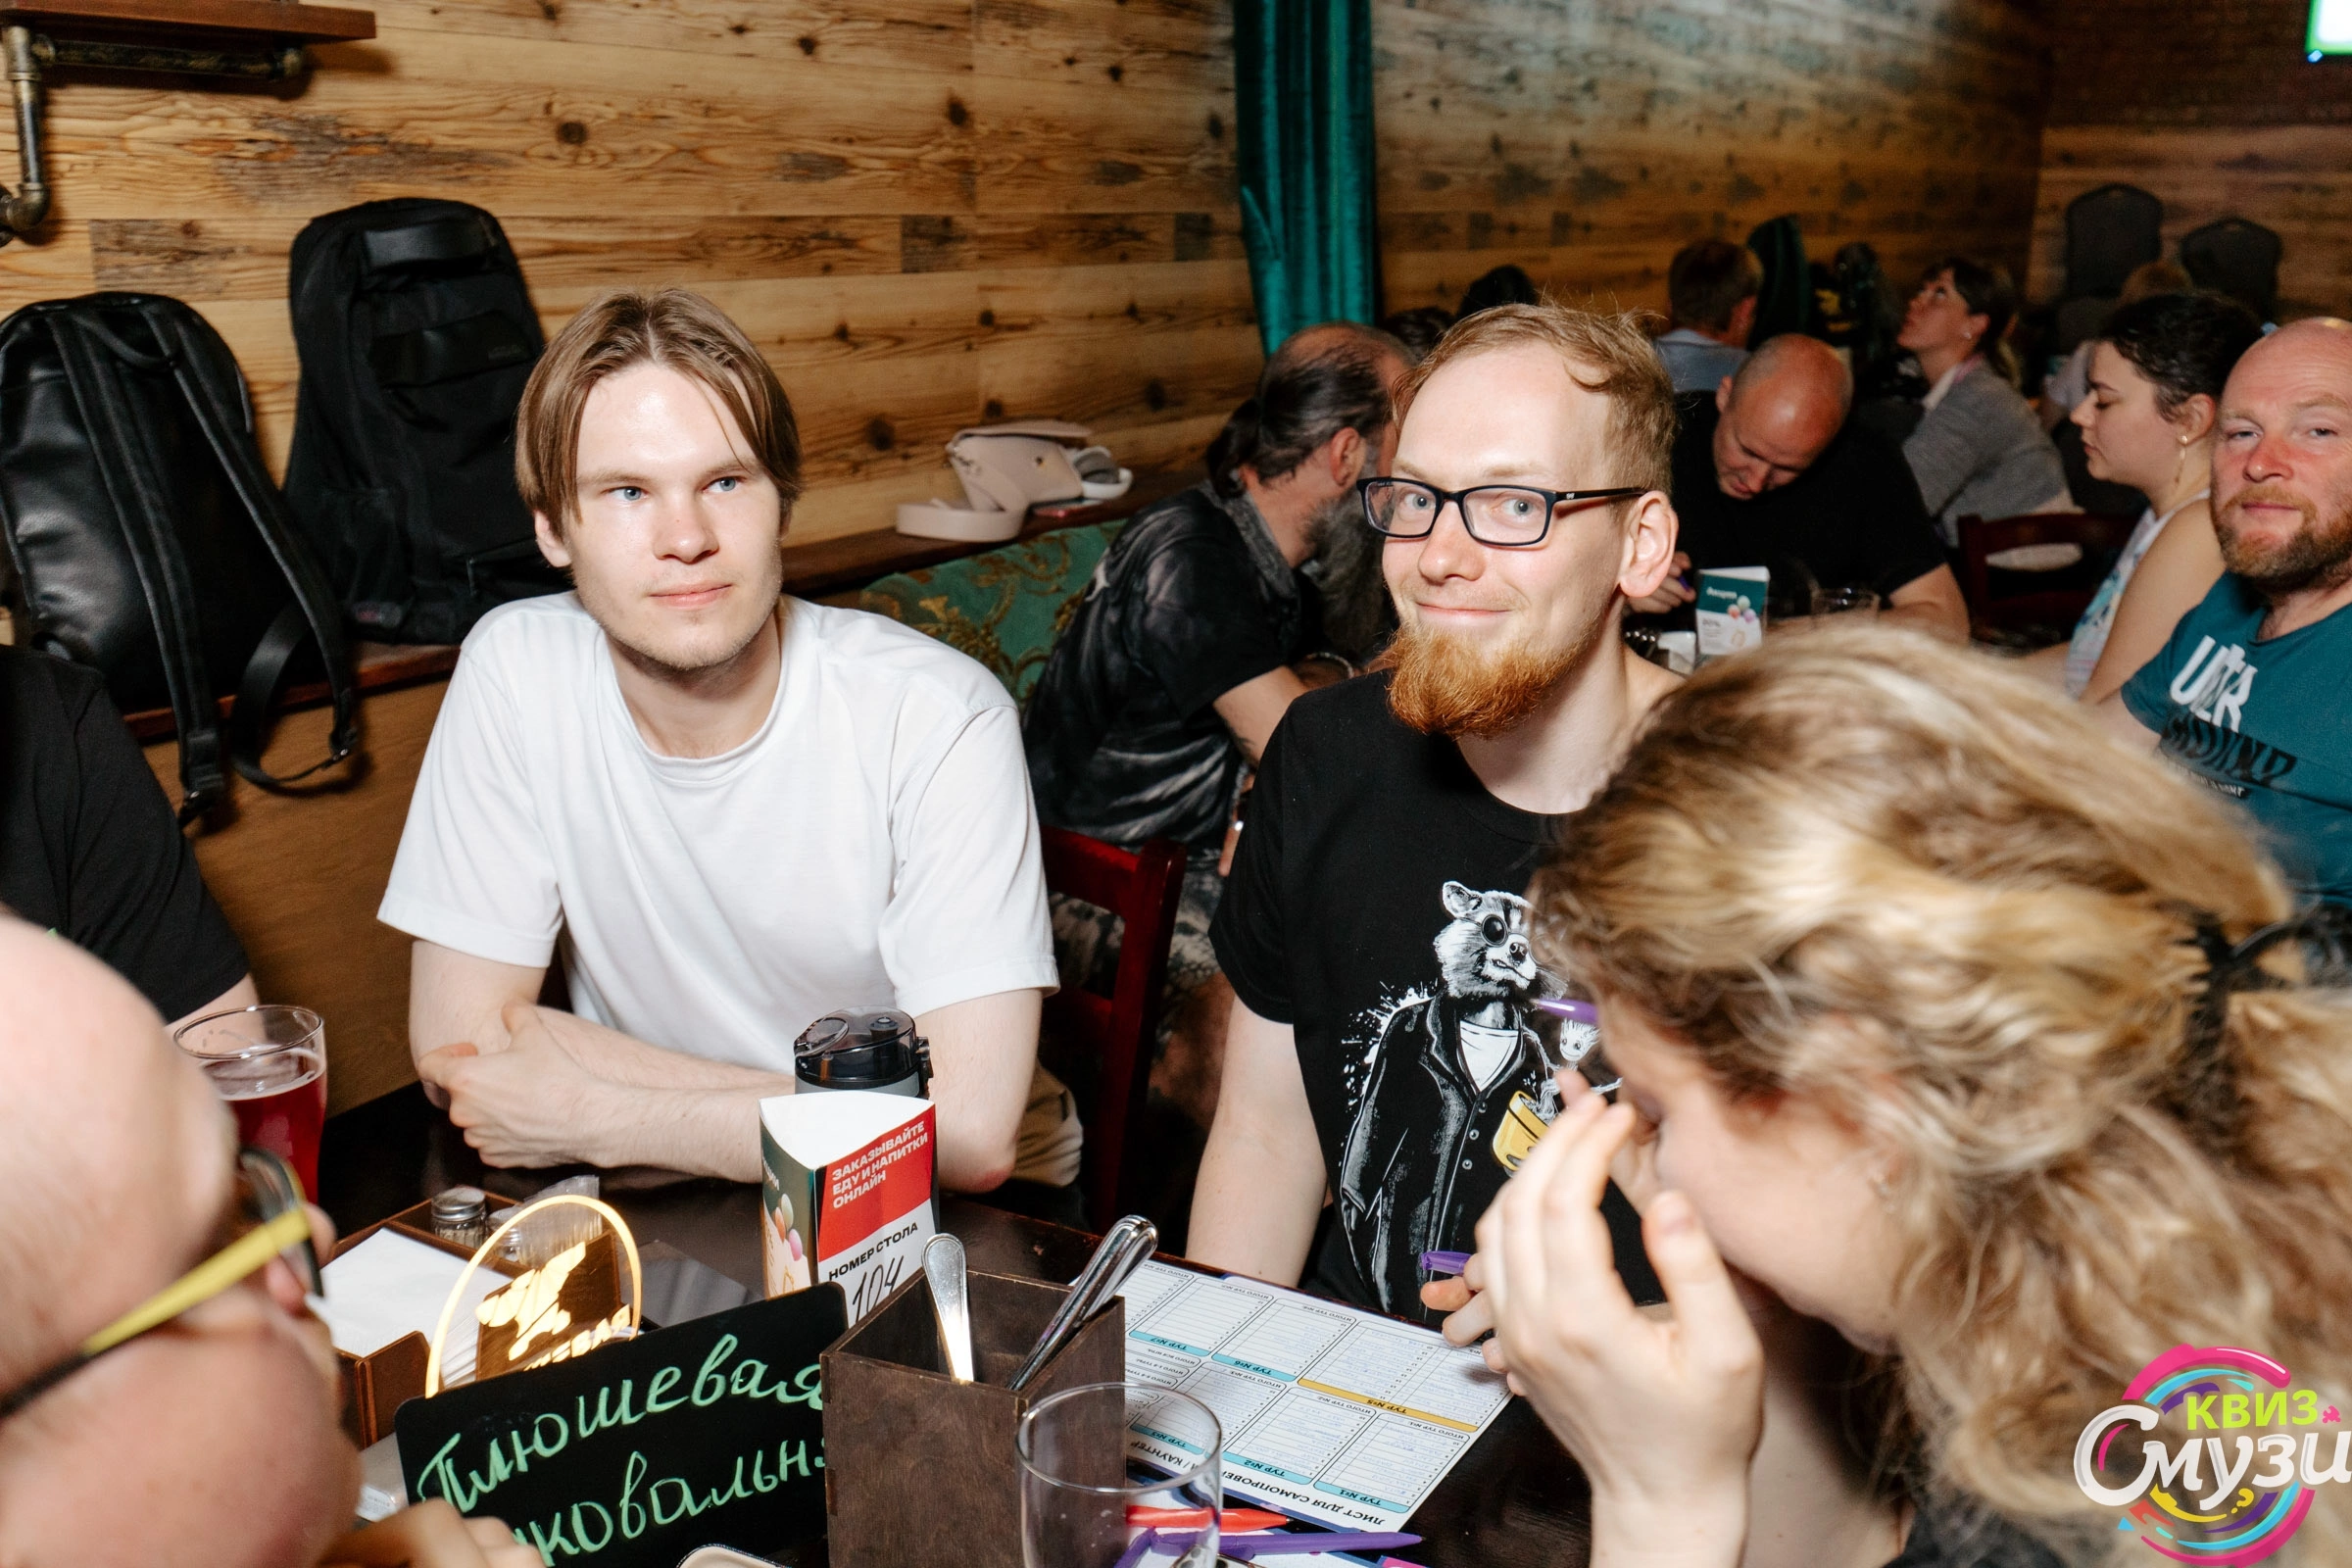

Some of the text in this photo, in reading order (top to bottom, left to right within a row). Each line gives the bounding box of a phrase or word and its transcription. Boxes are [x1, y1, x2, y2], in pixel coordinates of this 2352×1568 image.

[832, 1121, 925, 1181] ЗАКАЗЫВАЙТЕ
[832, 1132, 928, 1196] ЕДУ И НАПИТКИ
[833, 1169, 887, 1209] ОНЛАЙН
[828, 1222, 918, 1282] НОМЕР СТОЛА
[852, 1255, 905, 1324] 104
[1151, 1337, 1187, 1350] ТУР №7
[1233, 1360, 1272, 1376] ТУР №6
[1367, 1398, 1407, 1414] ТУР №5
[1167, 1437, 1187, 1448] ТУР
[1438, 1429, 1464, 1440] ИТОГО
[1130, 1441, 1183, 1466] КАУНТЕР
[1244, 1459, 1285, 1477] ТУР №2
[1311, 1498, 1343, 1512] ДЛЯ
[1339, 1489, 1382, 1506] ТУР №1
[1343, 1508, 1386, 1526] ЛИСТ
